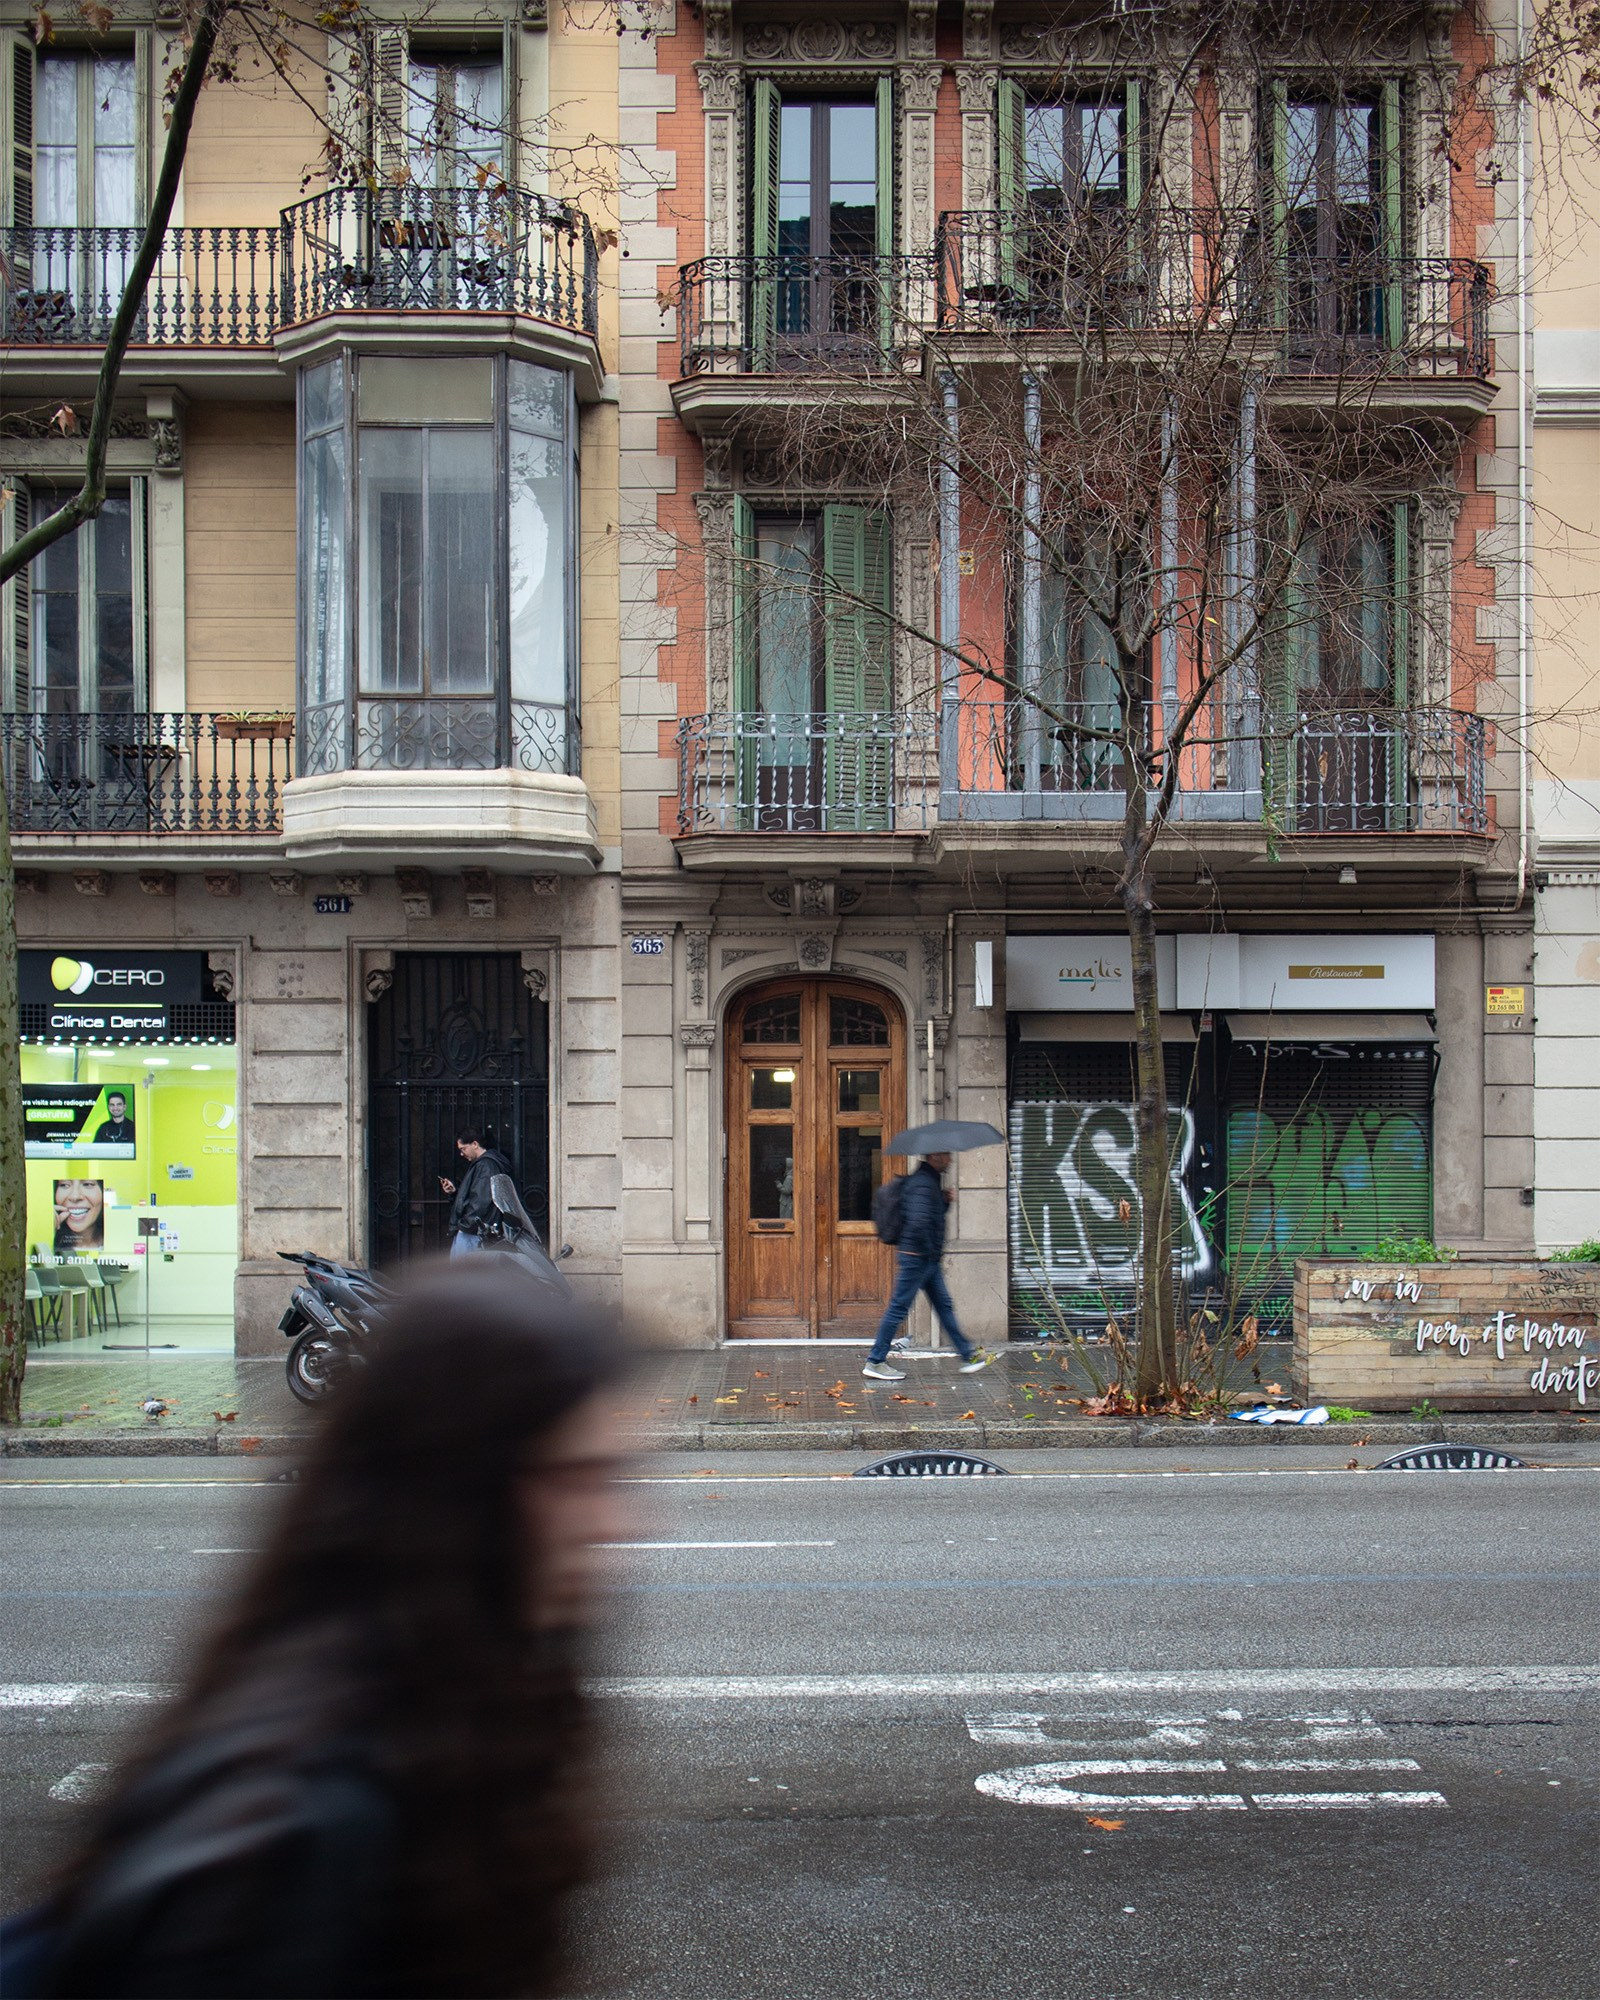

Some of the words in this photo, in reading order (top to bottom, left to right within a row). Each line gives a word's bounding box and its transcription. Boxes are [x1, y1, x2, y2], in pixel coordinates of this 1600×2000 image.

[318, 898, 346, 912] 361
[634, 939, 661, 953] 363
[93, 969, 165, 986] CERO
[1309, 967, 1364, 978] Restaurant
[50, 1015, 105, 1029] Clínica
[110, 1016, 166, 1029] Dental
[66, 1254, 94, 1265] amb
[1522, 1320, 1587, 1352] para
